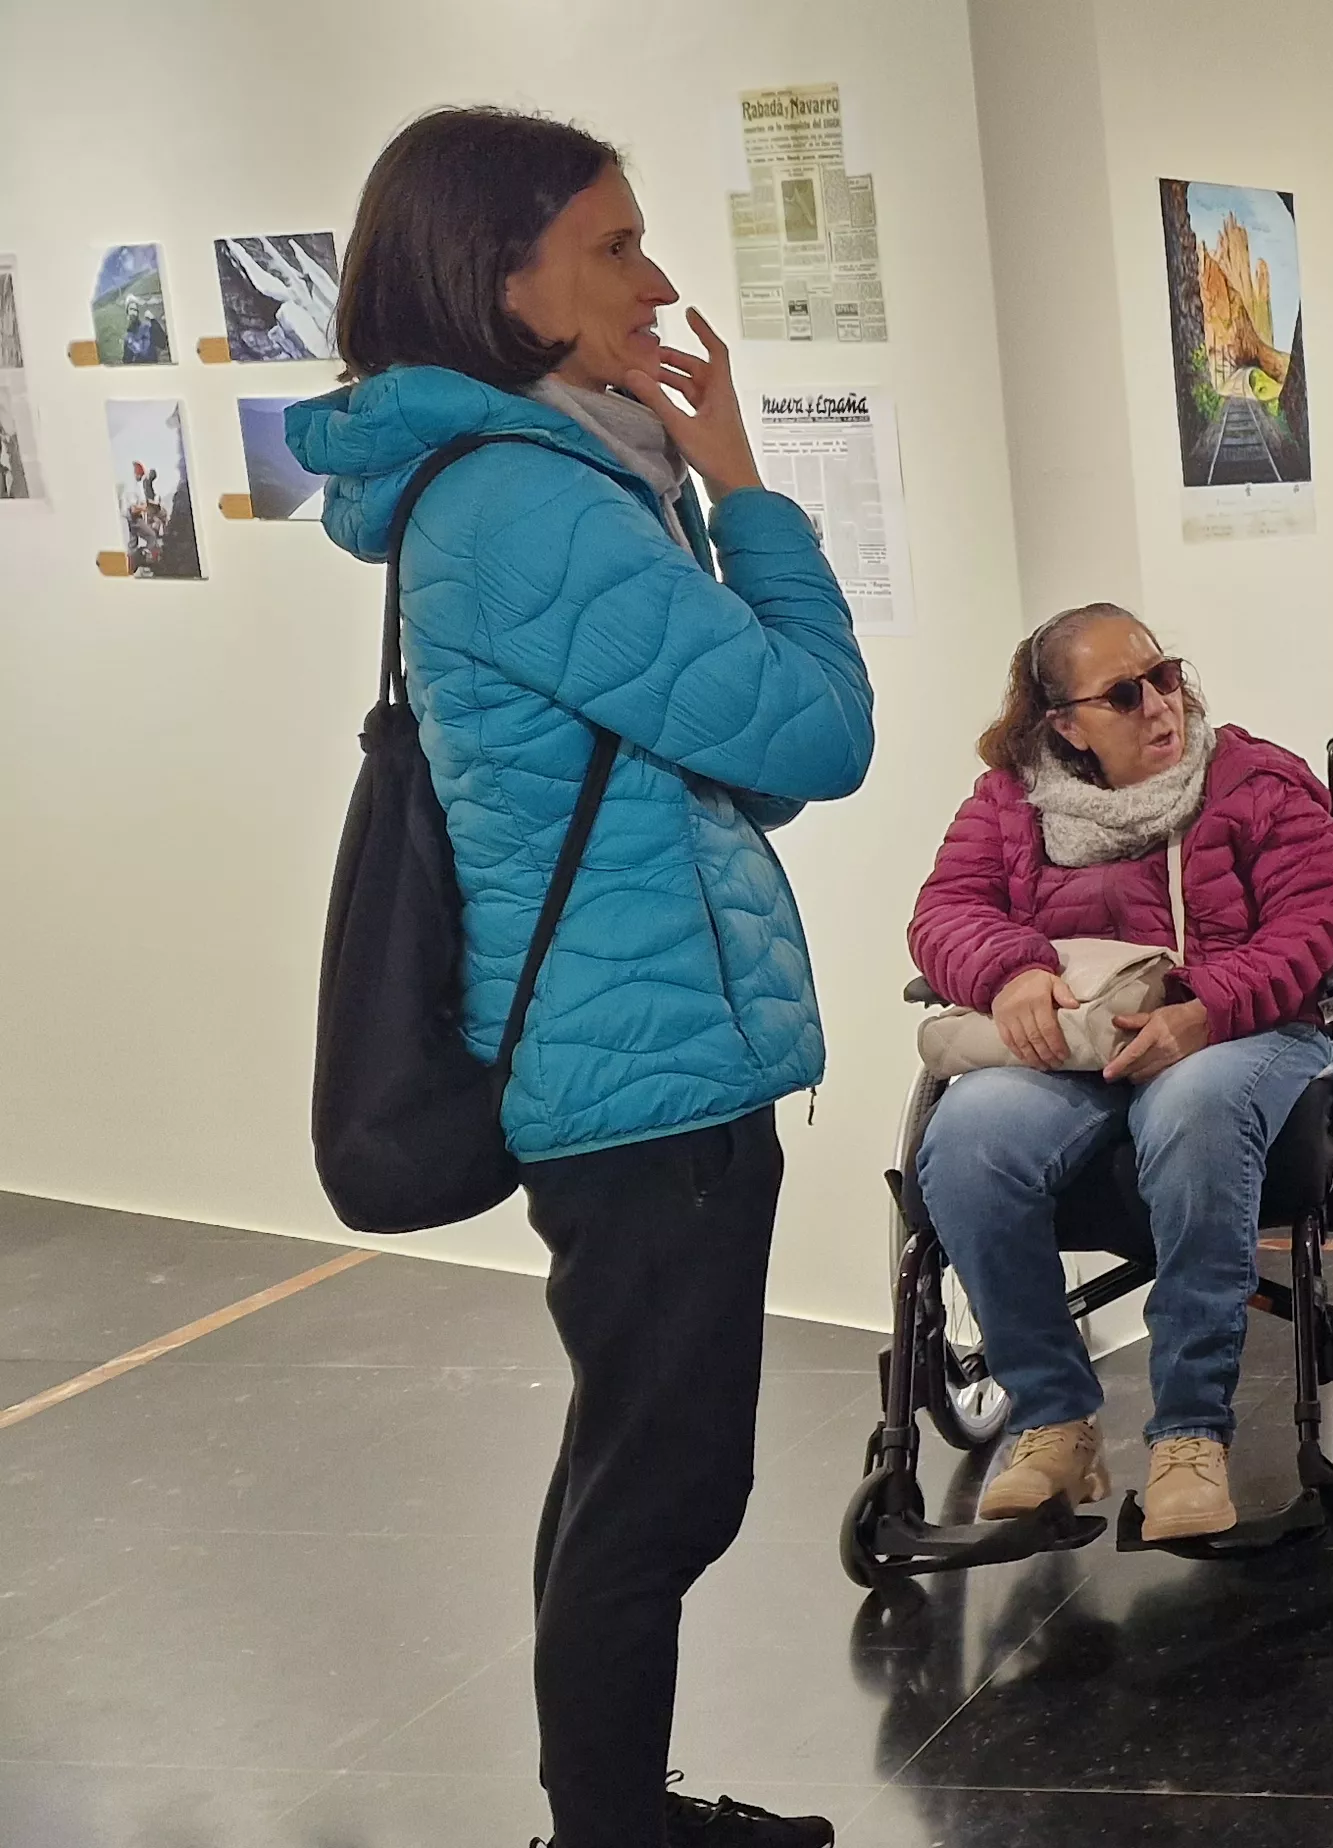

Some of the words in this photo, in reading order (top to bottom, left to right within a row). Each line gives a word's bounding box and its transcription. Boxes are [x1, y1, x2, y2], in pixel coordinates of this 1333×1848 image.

[742, 98, 783, 121] Rabadá
[790, 96, 839, 119] Navarro
[816, 392, 869, 417] España
